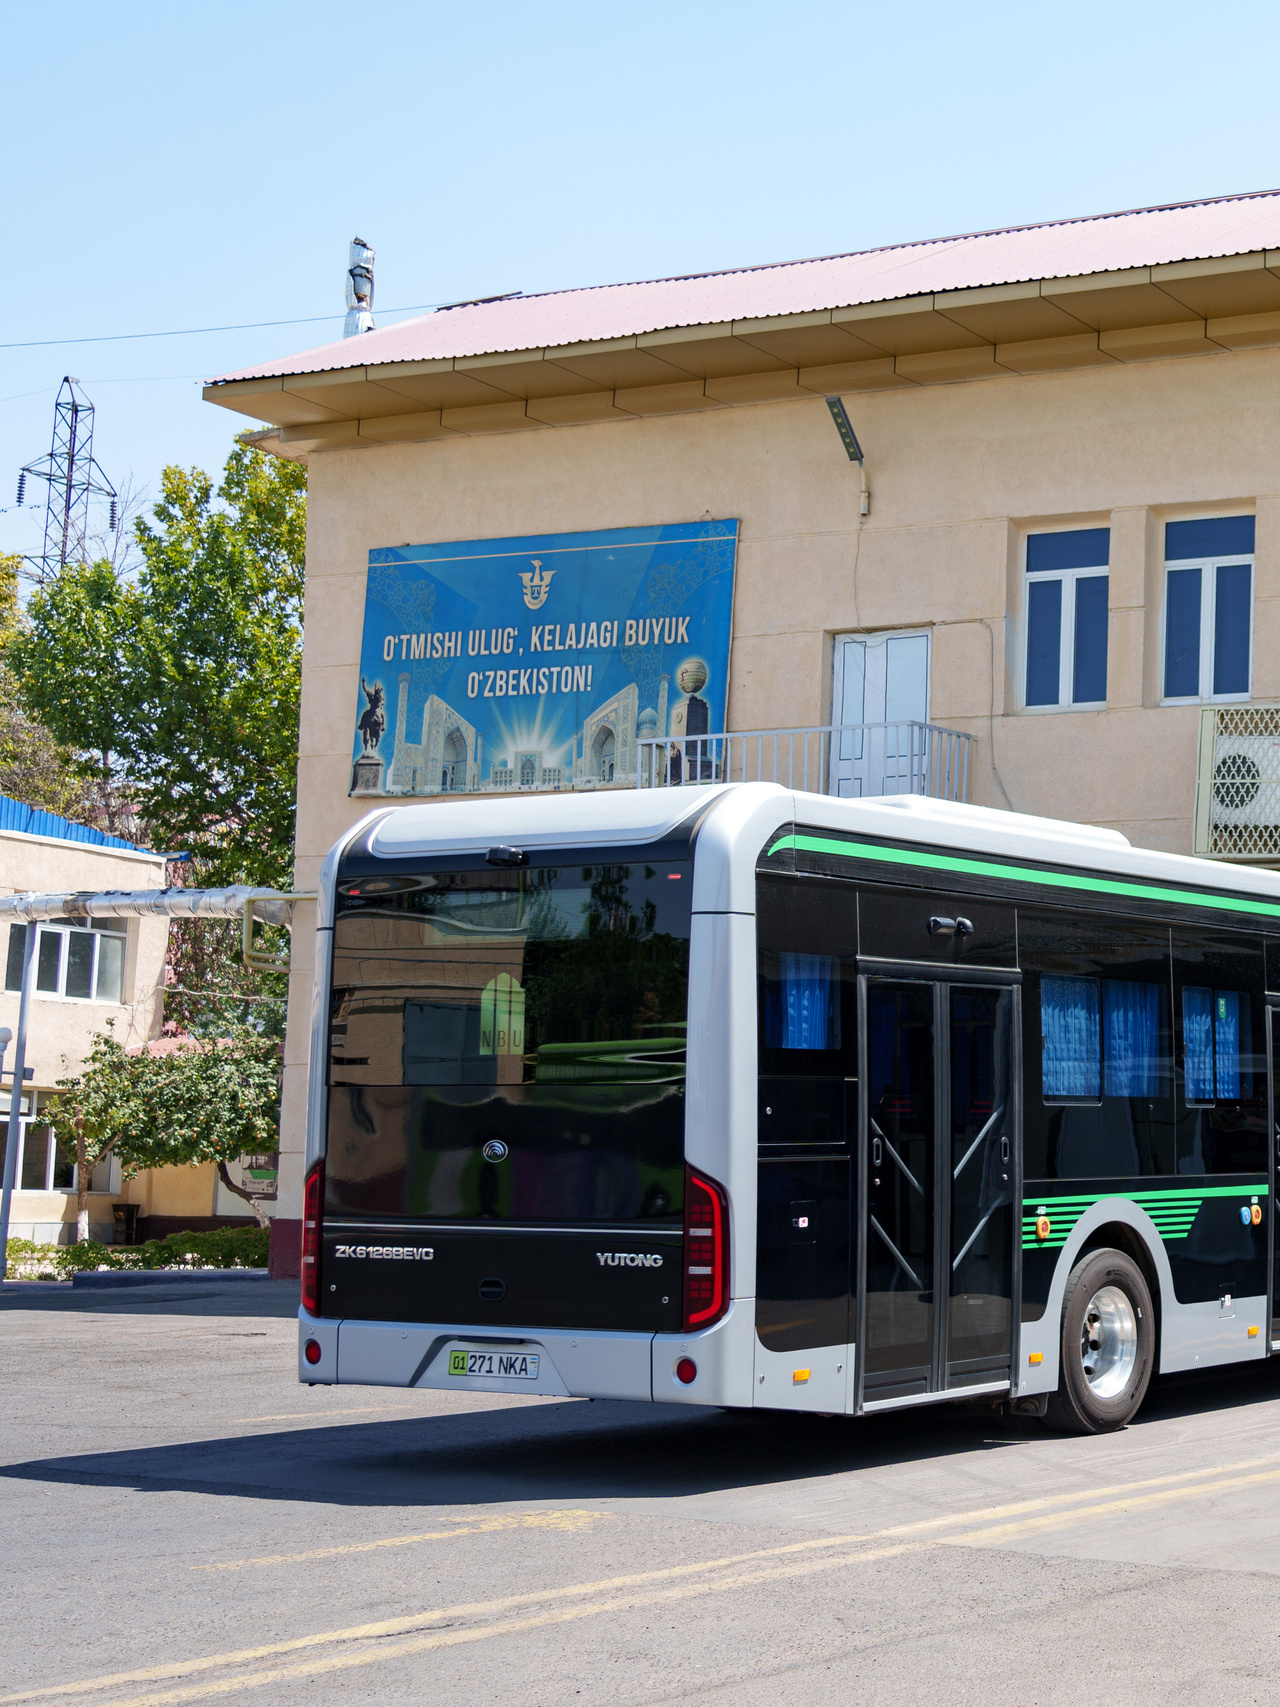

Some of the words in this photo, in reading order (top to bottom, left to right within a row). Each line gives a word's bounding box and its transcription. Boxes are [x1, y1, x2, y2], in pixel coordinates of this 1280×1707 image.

[530, 620, 618, 653] KELAJAGI
[624, 616, 691, 647] BUYUK
[482, 1030, 522, 1048] NBU
[335, 1245, 434, 1260] ZK6126BEVG
[596, 1252, 664, 1267] YUTONG
[468, 1355, 494, 1373] 271
[498, 1356, 528, 1375] NKA
